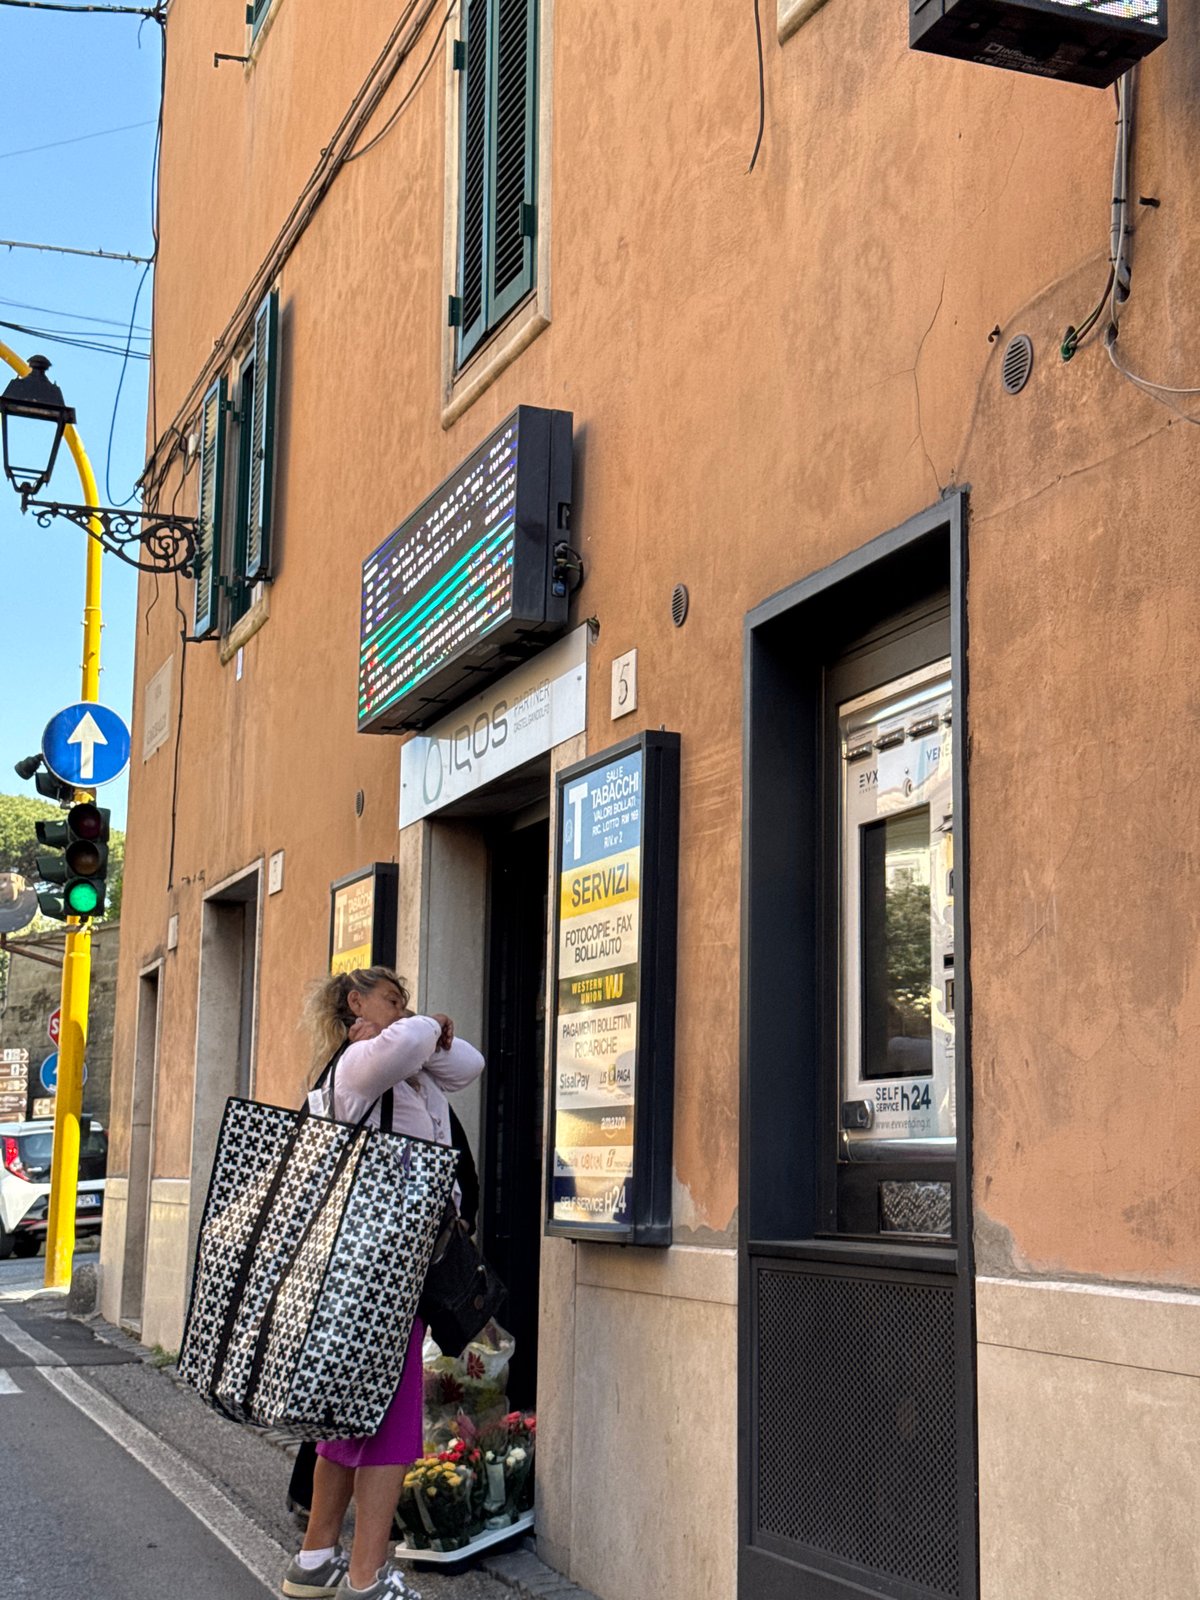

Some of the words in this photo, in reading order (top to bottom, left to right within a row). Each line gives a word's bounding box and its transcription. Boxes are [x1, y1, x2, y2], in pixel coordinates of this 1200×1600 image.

[513, 678, 550, 718] PARTNER
[618, 662, 629, 706] 5
[448, 699, 509, 776] IQOS
[605, 768, 619, 784] SALI
[619, 765, 624, 778] E
[591, 771, 639, 809] TABACCHI
[568, 782, 588, 861] T
[593, 804, 613, 823] VALORI
[613, 795, 636, 815] BOLLATI
[602, 817, 620, 833] LOTTO
[571, 861, 629, 908] SERVIZI
[565, 920, 611, 948] FOTOCOPIE
[616, 913, 633, 935] FAX
[574, 943, 598, 964] BOLLI
[598, 936, 622, 959] AUTO
[571, 977, 603, 995] WESTERN
[580, 989, 603, 1005] UNION
[562, 1018, 597, 1040] PAGAMENTI
[597, 1013, 632, 1034] BOLLETTINI
[559, 1071, 590, 1091] SisalPay
[876, 1086, 899, 1102] SELF
[900, 1083, 932, 1112] h24
[876, 1102, 900, 1113] SERVICE
[600, 1116, 626, 1131] amazon
[576, 1196, 604, 1213] SERVICE
[604, 1185, 627, 1214] H24
